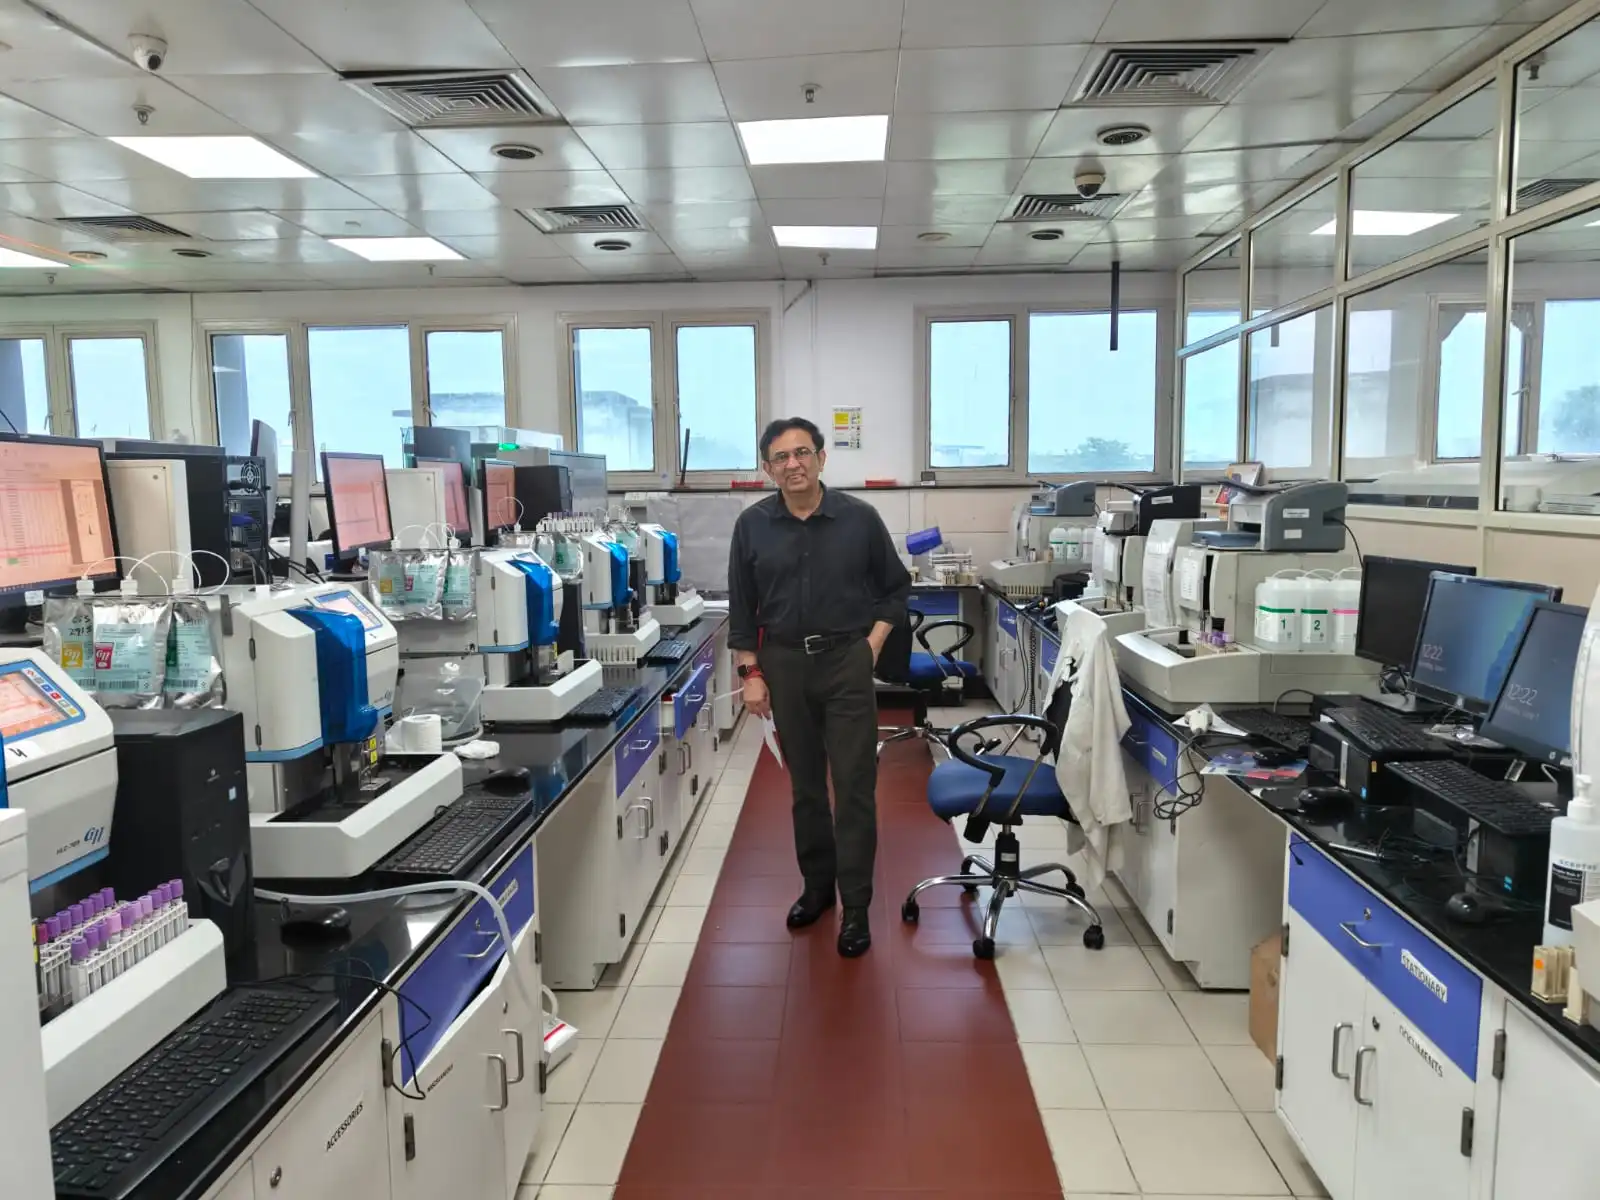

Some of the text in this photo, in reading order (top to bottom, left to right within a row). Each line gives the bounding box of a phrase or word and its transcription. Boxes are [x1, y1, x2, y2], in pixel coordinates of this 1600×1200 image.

[1281, 617, 1286, 630] 1
[1314, 620, 1321, 630] 2
[1402, 955, 1446, 1000] STATIONARY
[1399, 1025, 1443, 1077] DOCUMENTS
[326, 1100, 363, 1151] ACCESSORIES
